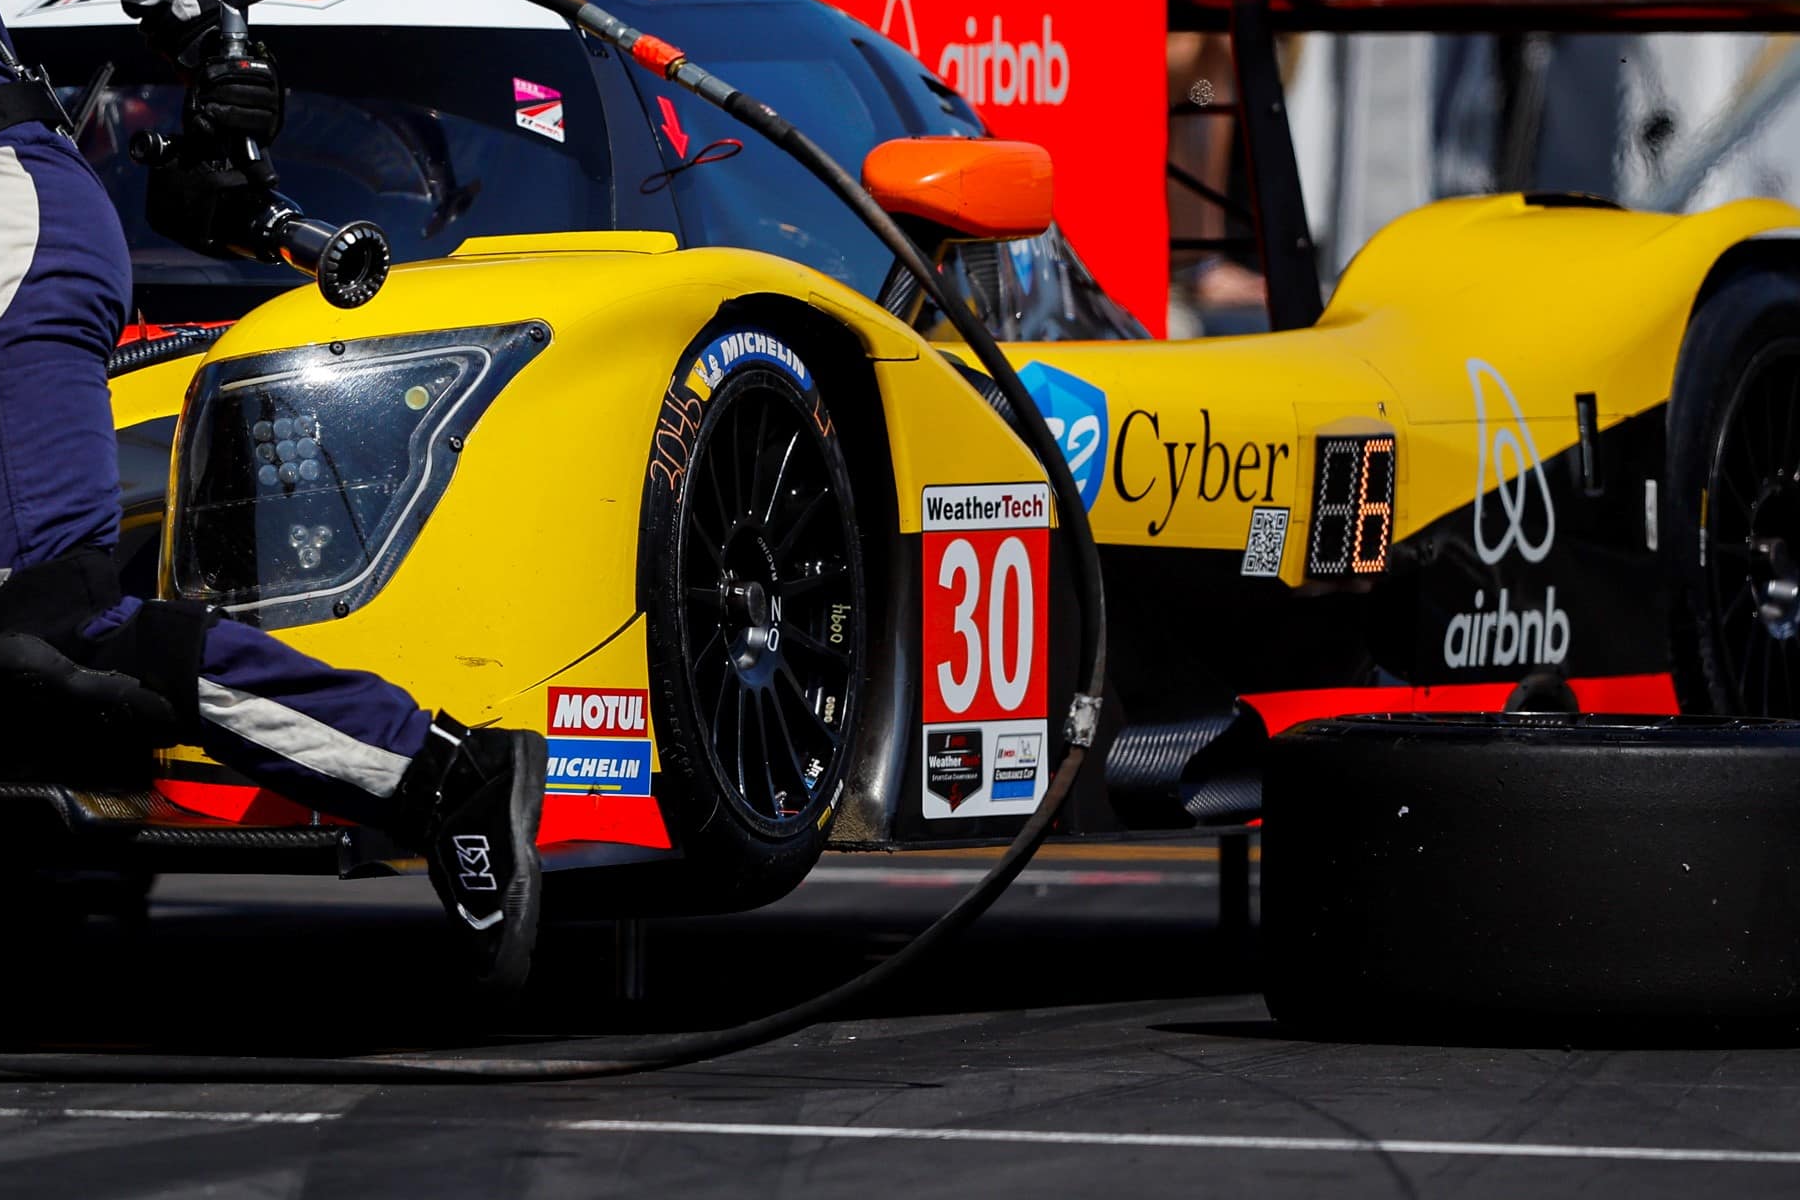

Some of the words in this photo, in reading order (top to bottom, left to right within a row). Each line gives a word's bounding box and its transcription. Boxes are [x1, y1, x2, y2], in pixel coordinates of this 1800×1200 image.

[937, 13, 1071, 107] airbnb
[720, 331, 806, 381] MICHELIN
[927, 494, 1043, 521] WeatherTech
[1113, 408, 1290, 537] Cyber
[937, 535, 1034, 714] 30
[1443, 584, 1571, 670] airbnb
[552, 693, 646, 731] MOTUL
